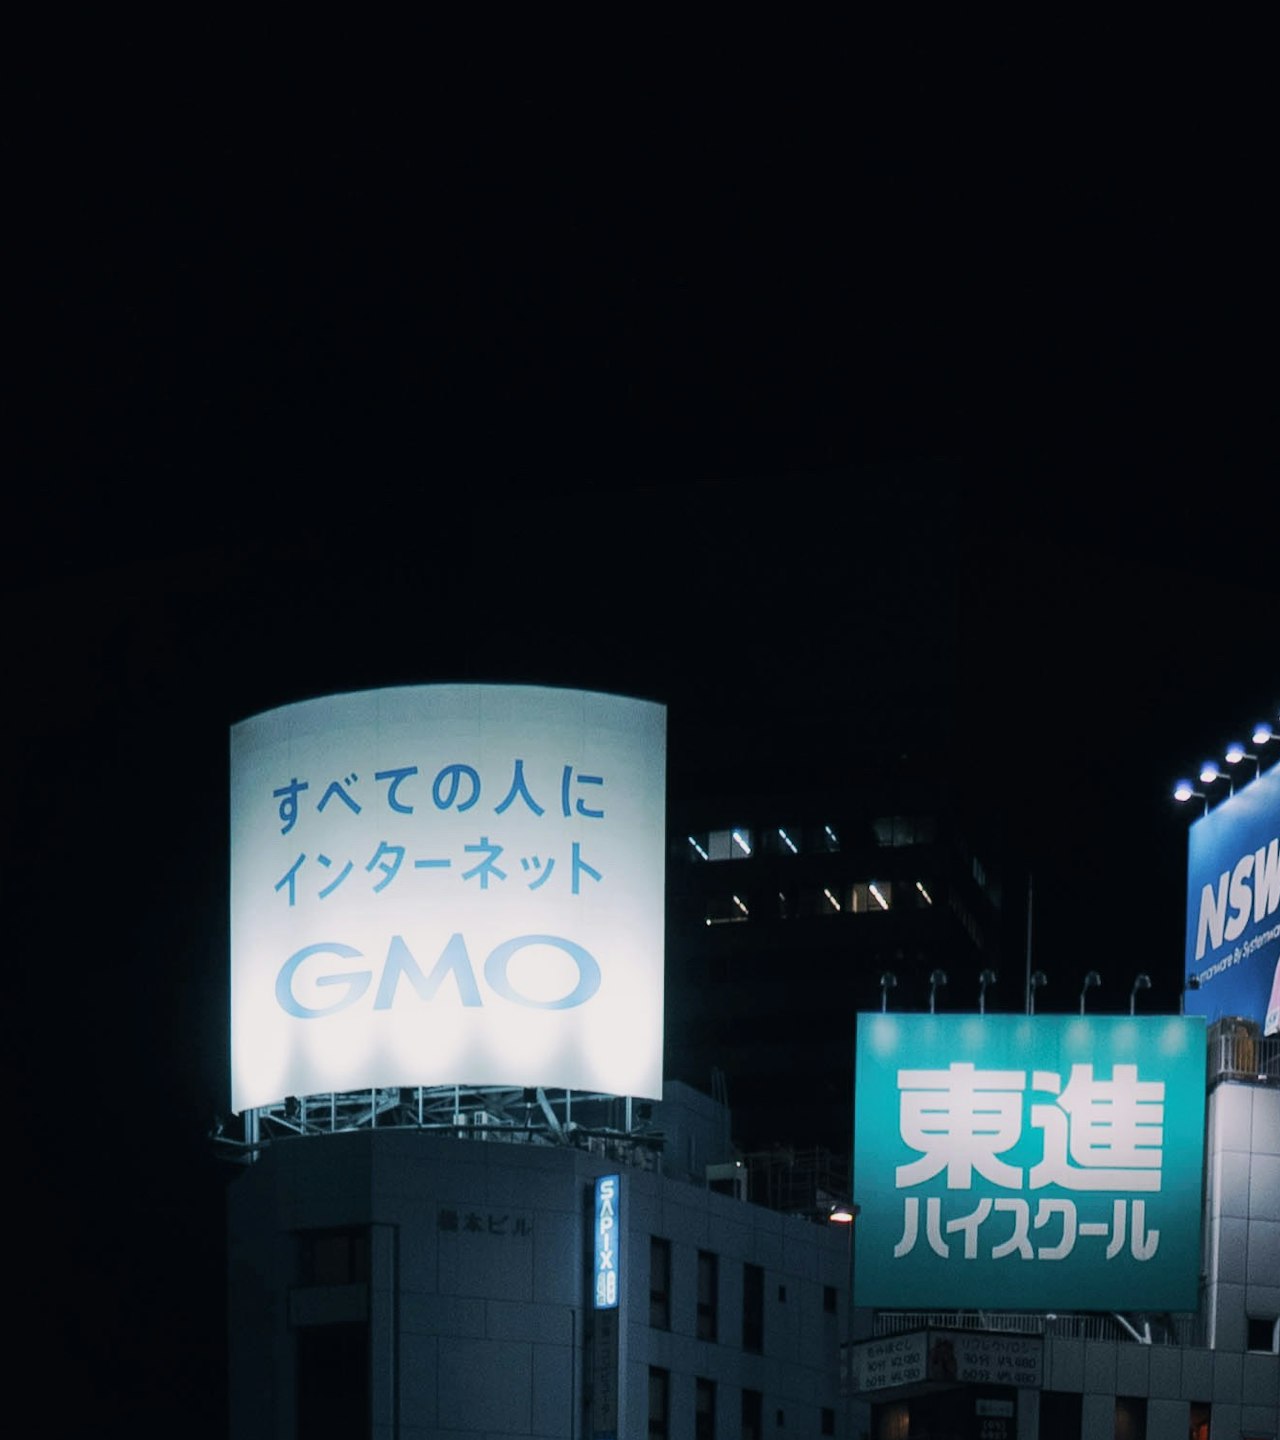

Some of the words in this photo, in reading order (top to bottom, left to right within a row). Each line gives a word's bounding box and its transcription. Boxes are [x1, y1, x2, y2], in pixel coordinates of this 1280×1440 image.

[273, 759, 605, 834] すべての人に
[273, 836, 603, 906] インターネット
[274, 932, 601, 1020] GMO
[895, 1062, 1165, 1191] 東進
[599, 1180, 615, 1270] SAPIX
[893, 1197, 1160, 1261] ハイスクール
